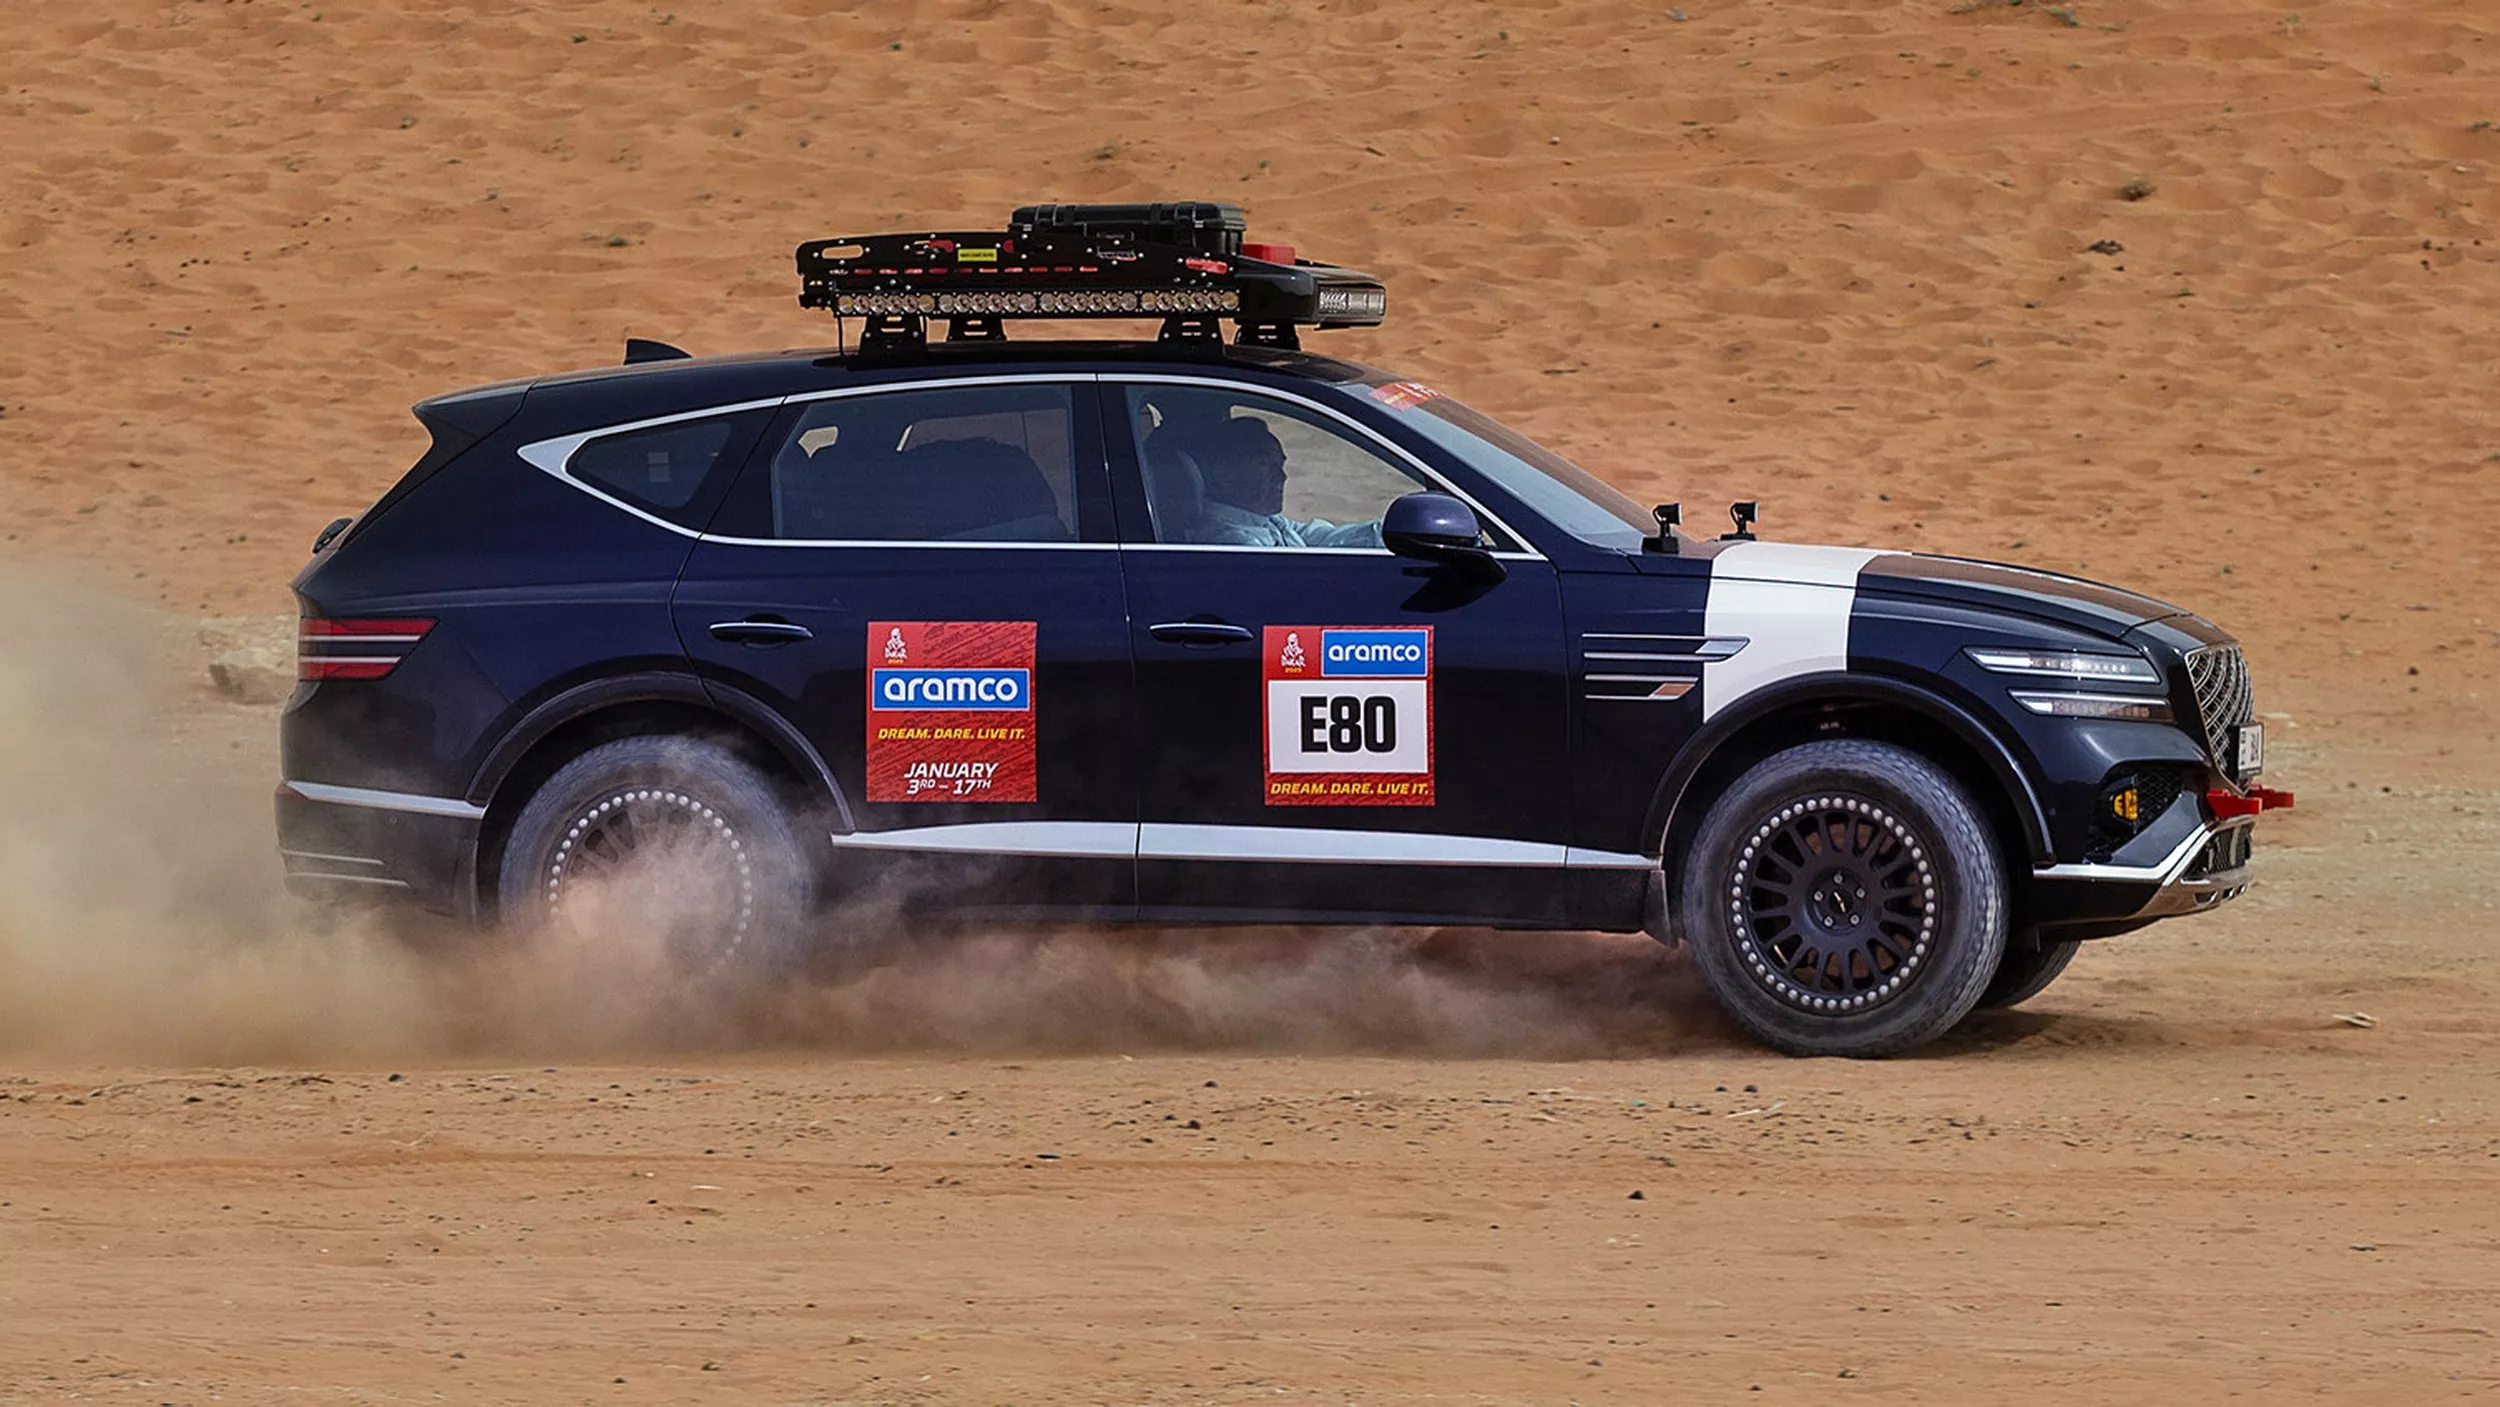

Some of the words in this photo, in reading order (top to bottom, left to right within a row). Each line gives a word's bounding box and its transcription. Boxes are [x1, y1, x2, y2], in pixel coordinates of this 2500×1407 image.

[1328, 644, 1421, 662] aramco
[883, 677, 1019, 701] aramco
[1300, 695, 1397, 753] E80
[877, 728, 932, 740] DREAM.
[933, 728, 975, 740] DARE.
[976, 728, 1008, 740] LIVE
[1008, 728, 1026, 740] IT.
[903, 762, 999, 779] JANUARY
[906, 779, 936, 795] 3RD
[952, 779, 992, 795] 17TH
[1270, 782, 1328, 795] DREAM.
[1330, 782, 1375, 795] DARE.
[1376, 782, 1409, 795] LIVE
[1411, 782, 1430, 795] IT.
